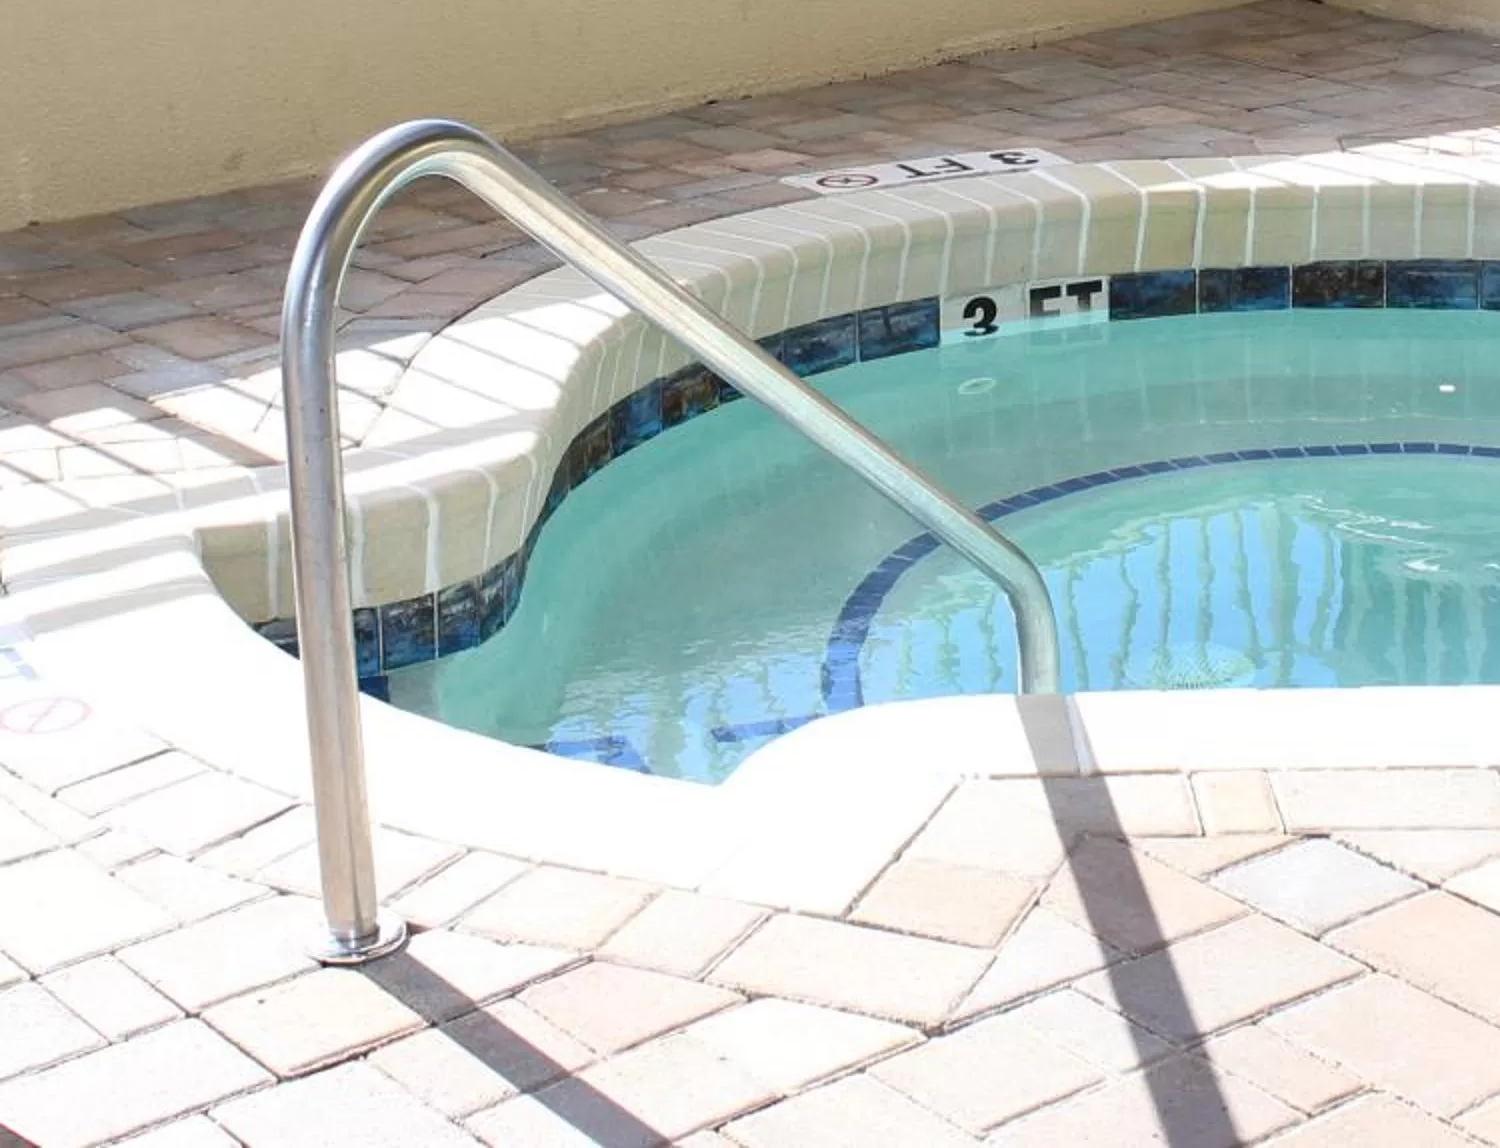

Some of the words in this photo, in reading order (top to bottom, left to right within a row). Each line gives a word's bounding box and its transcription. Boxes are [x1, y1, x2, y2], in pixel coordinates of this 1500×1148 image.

[897, 157, 974, 179] FT
[989, 151, 1039, 165] 3
[962, 296, 999, 337] 3
[1028, 279, 1104, 321] FT
